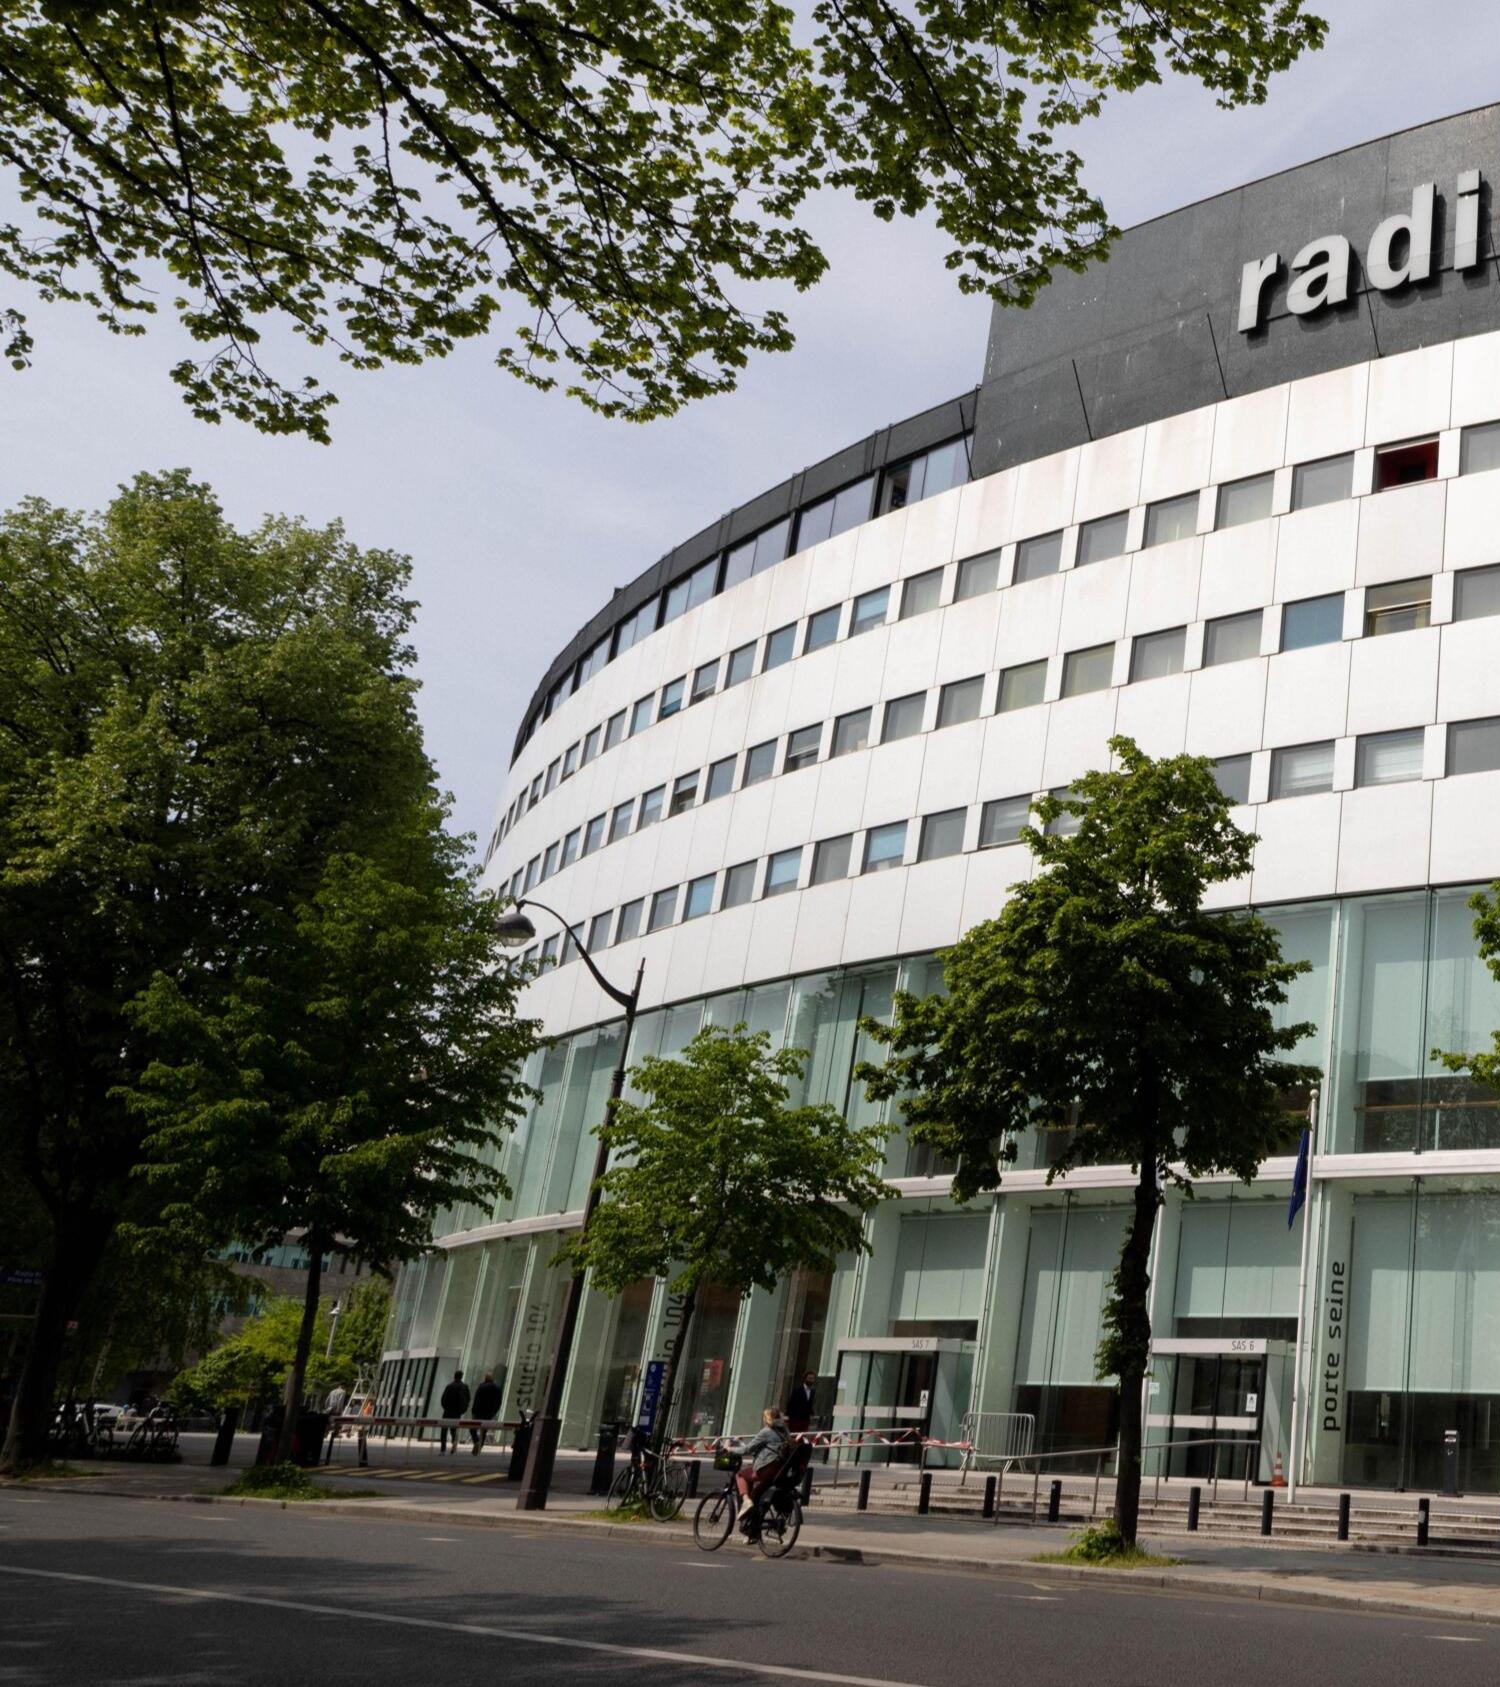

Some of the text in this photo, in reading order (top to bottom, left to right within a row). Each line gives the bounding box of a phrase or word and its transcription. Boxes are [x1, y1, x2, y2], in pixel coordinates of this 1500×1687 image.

[516, 1343, 541, 1408] studio
[1232, 1340, 1255, 1351] SAS 6
[1323, 1261, 1345, 1432] porte seine
